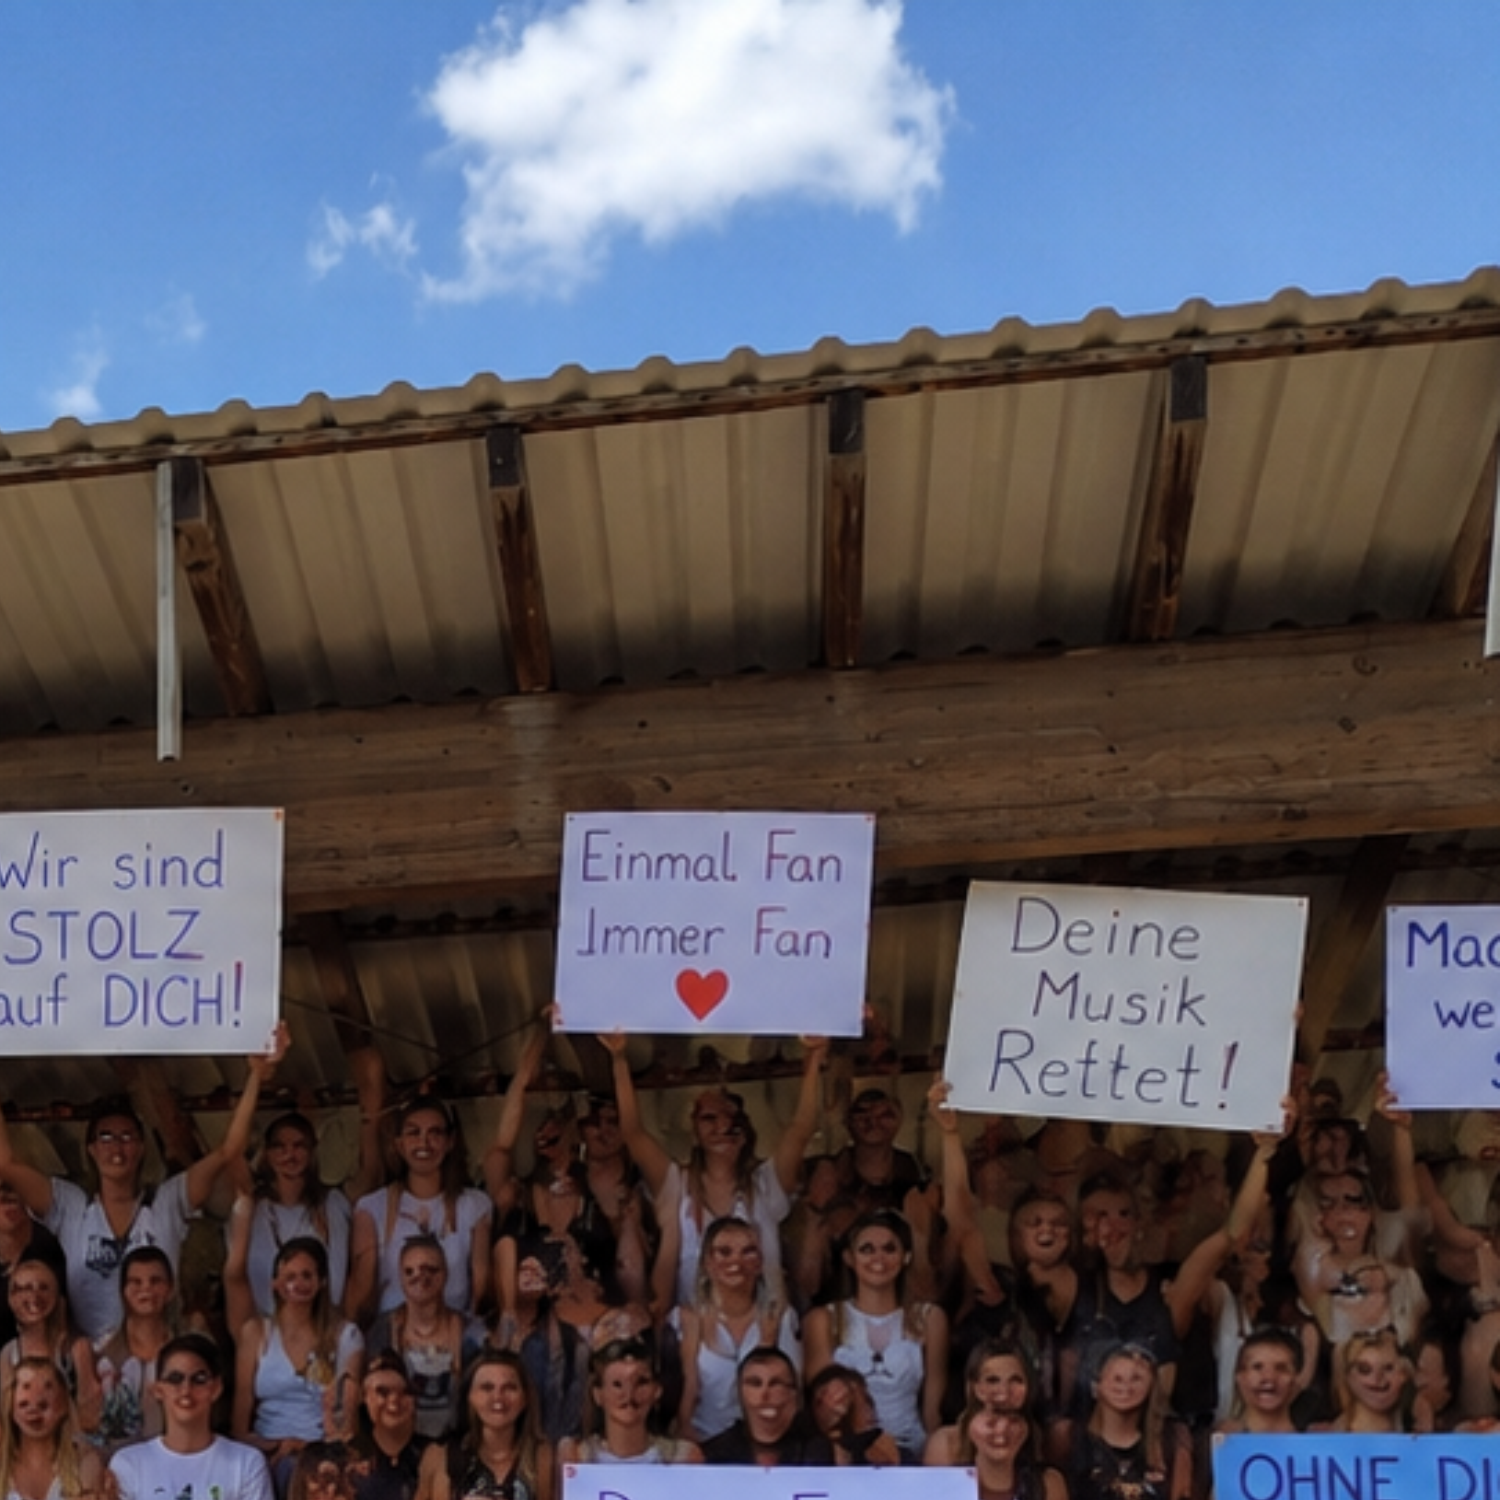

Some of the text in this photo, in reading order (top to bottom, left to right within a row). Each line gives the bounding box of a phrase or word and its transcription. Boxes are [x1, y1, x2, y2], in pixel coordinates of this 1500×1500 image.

[113, 829, 225, 890] sind
[581, 829, 842, 883] Einmal Fan
[3, 910, 205, 964] STOLZ
[754, 906, 833, 959] Fan
[1010, 897, 1202, 960] Deine
[102, 960, 245, 1028] DICH!
[1032, 971, 1206, 1026] Musik
[988, 1030, 1238, 1110] Rettet!
